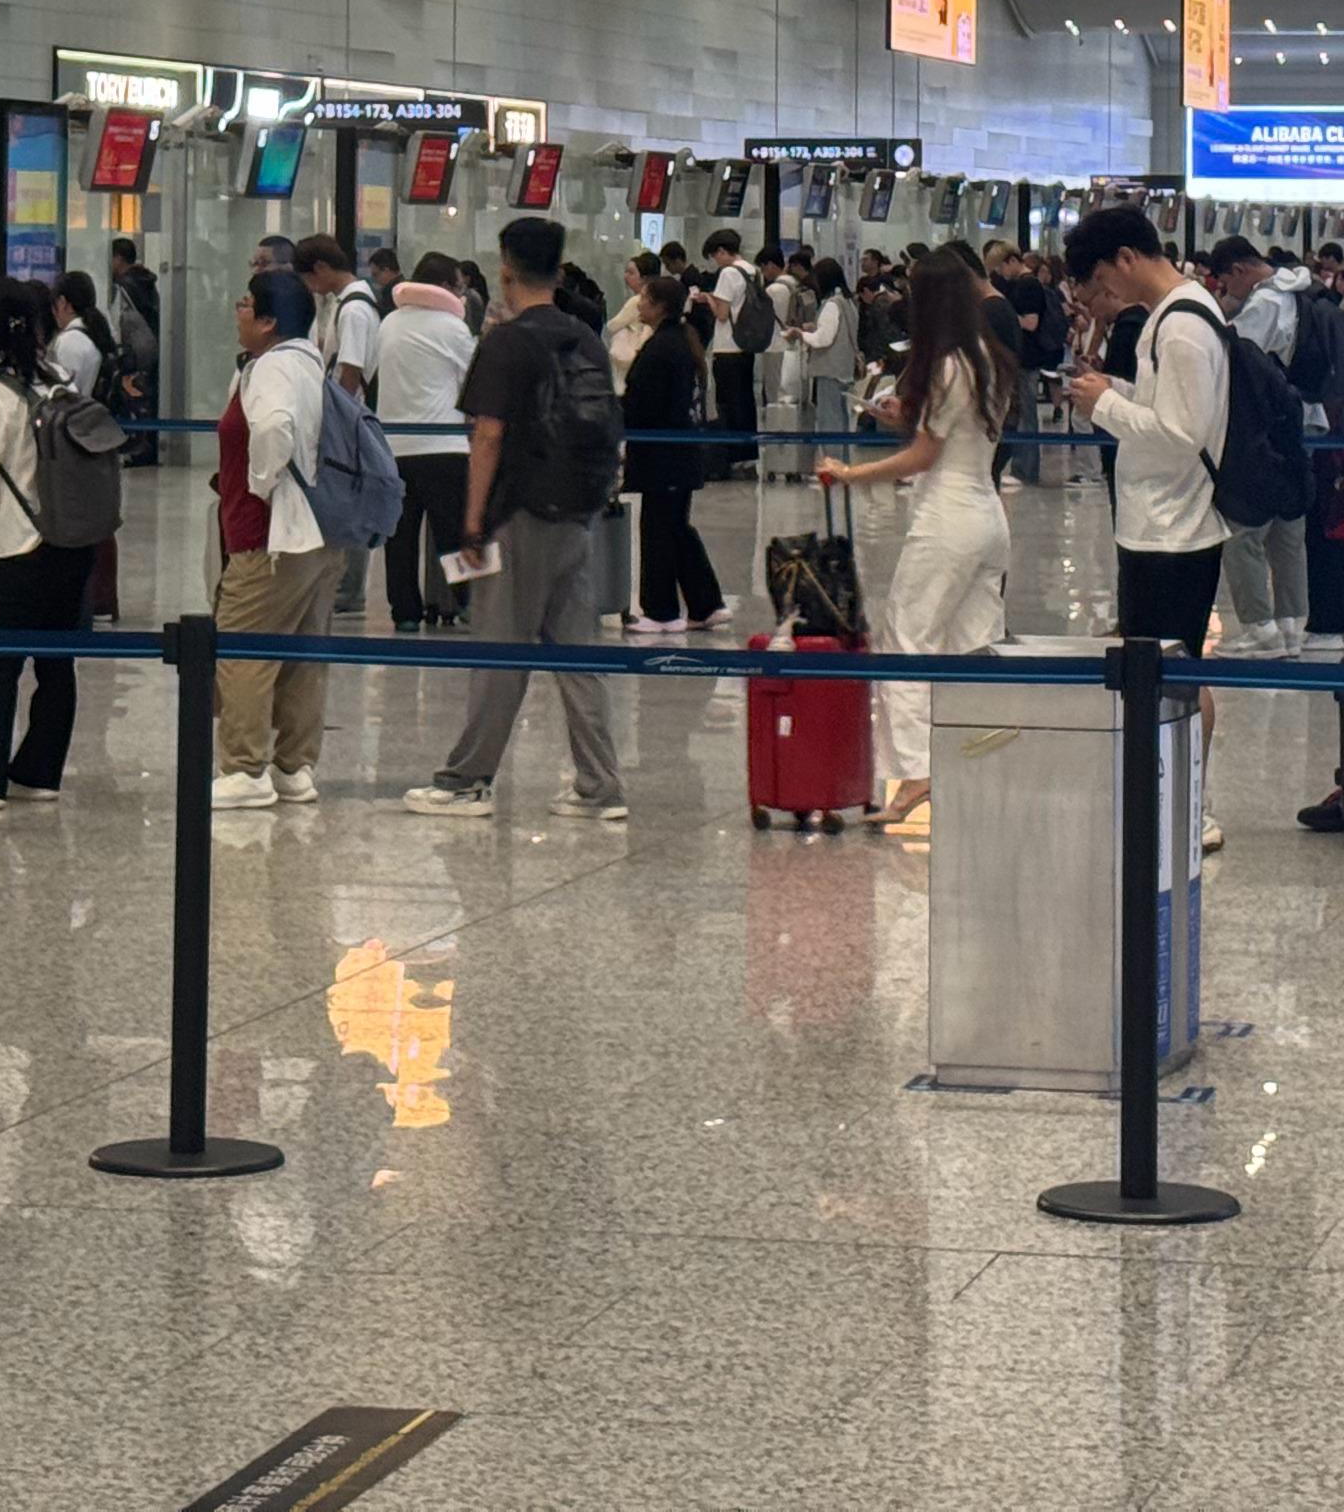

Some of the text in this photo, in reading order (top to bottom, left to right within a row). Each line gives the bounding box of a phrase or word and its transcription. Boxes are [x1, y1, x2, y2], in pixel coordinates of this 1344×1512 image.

[325, 103, 461, 120] B154-173, A303-304
[1251, 125, 1323, 142] ALIBABA
